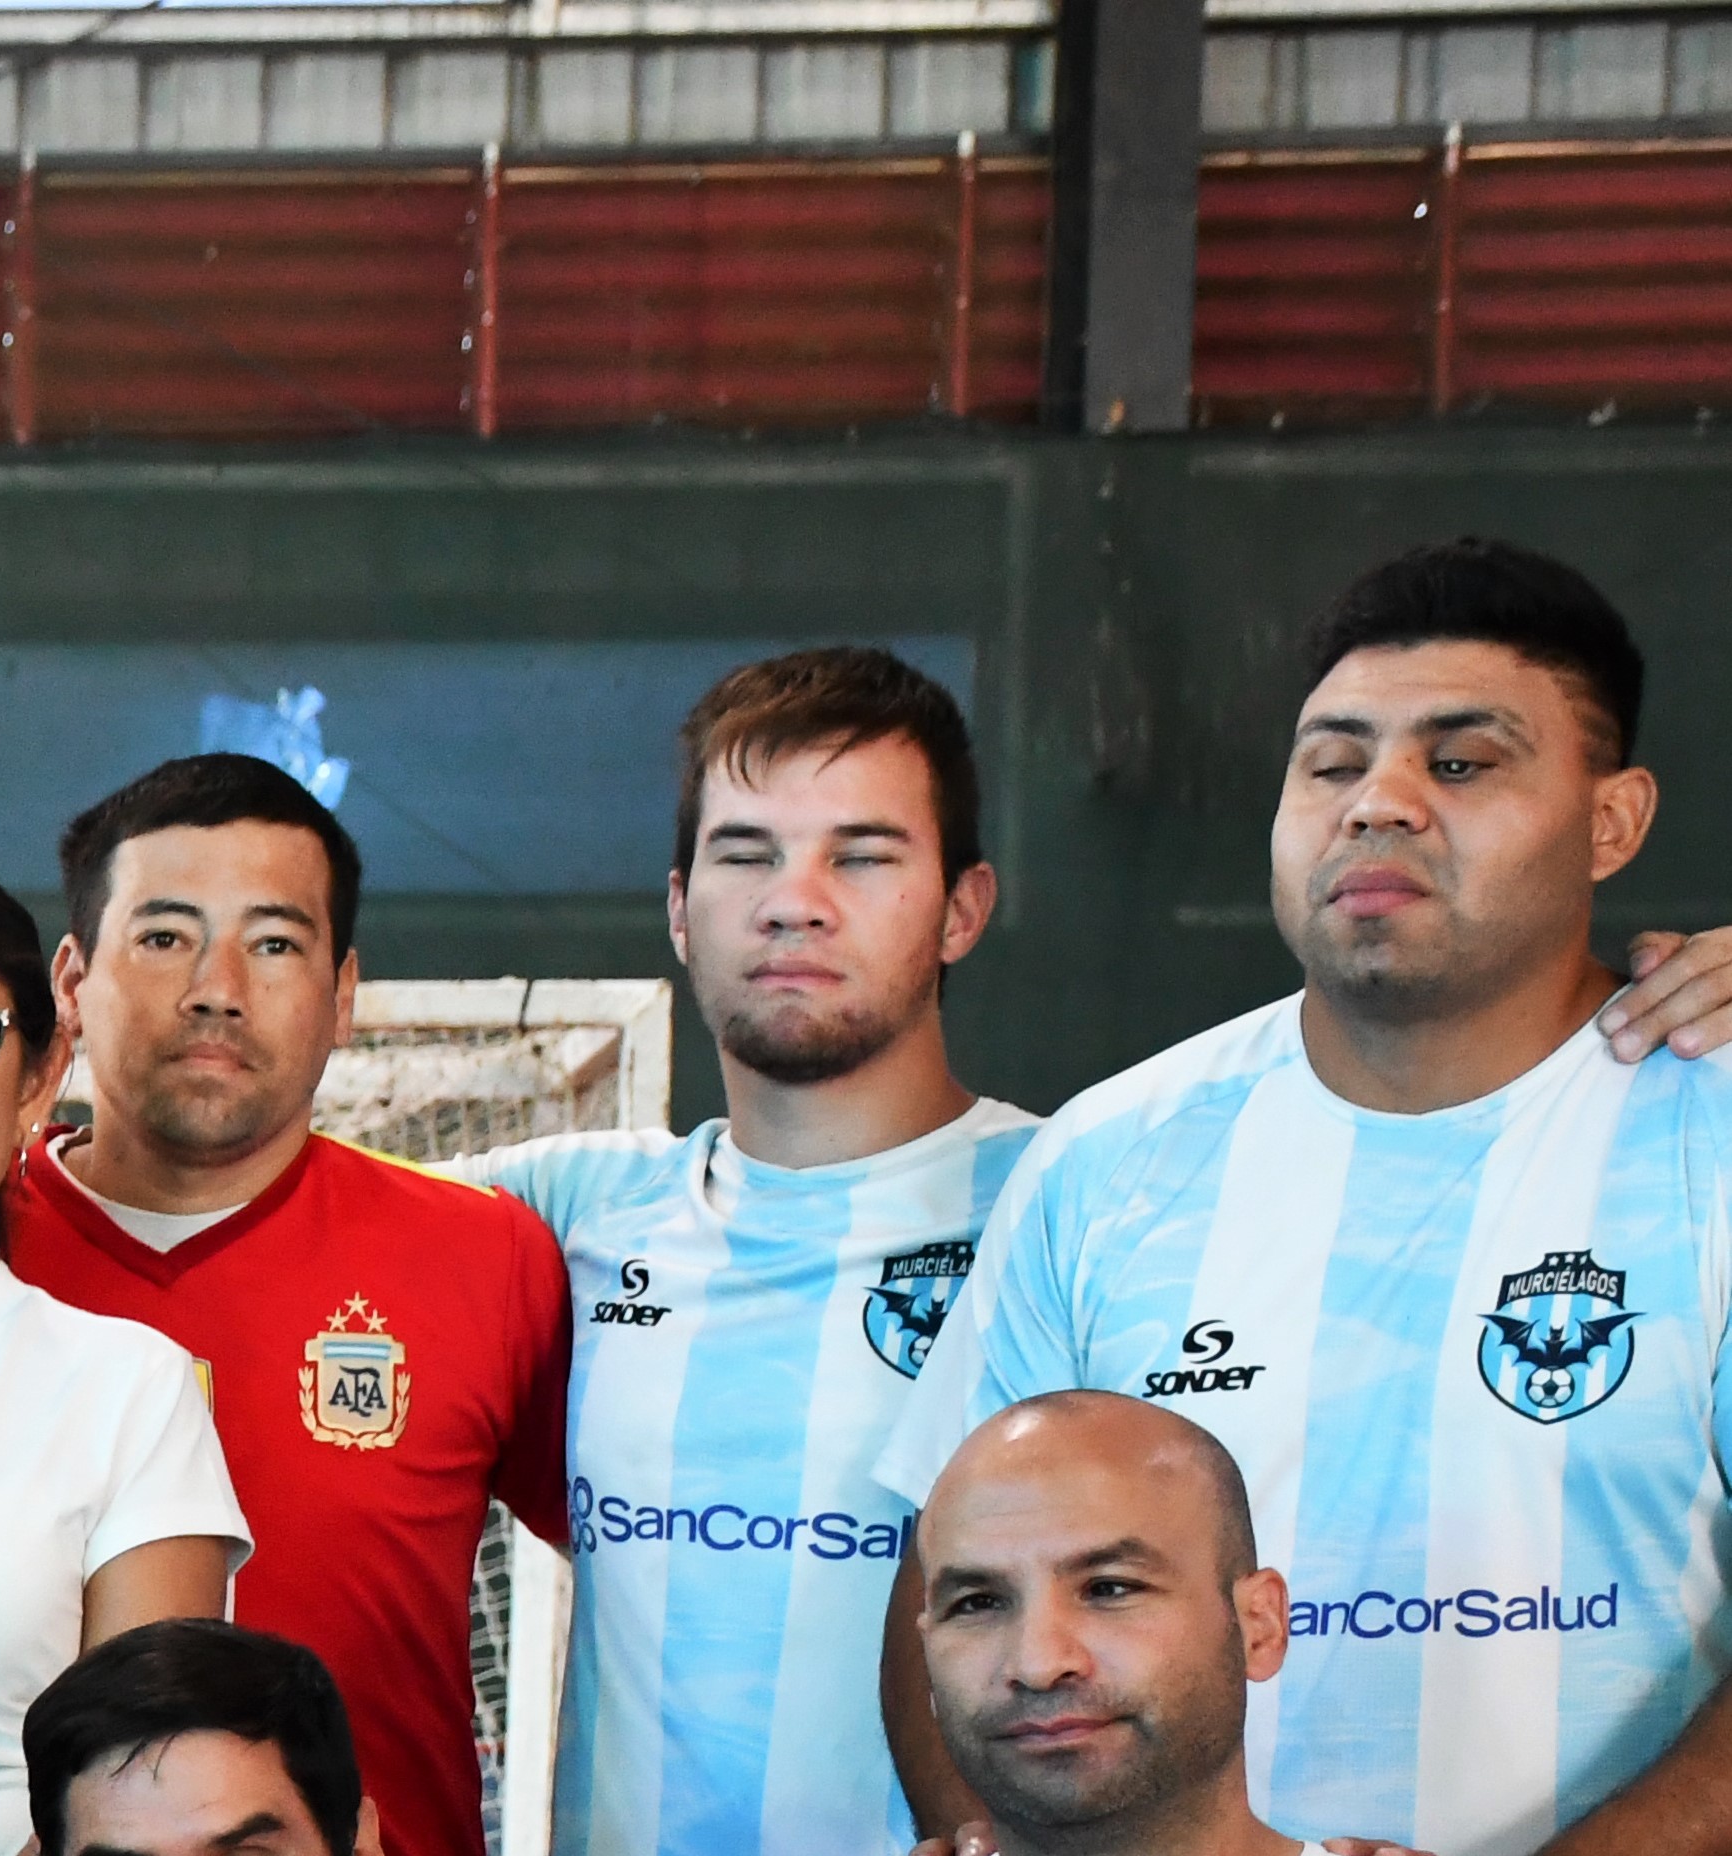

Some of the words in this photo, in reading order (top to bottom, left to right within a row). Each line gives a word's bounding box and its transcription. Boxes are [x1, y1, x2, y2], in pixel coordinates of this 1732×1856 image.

[890, 1253, 974, 1277] MURCIÉLA
[1507, 1265, 1619, 1302] MURCIÉLAGOS
[329, 1364, 387, 1417] AFA
[598, 1495, 913, 1561] SanCorSal
[1288, 1582, 1619, 1640] anCorSalud
